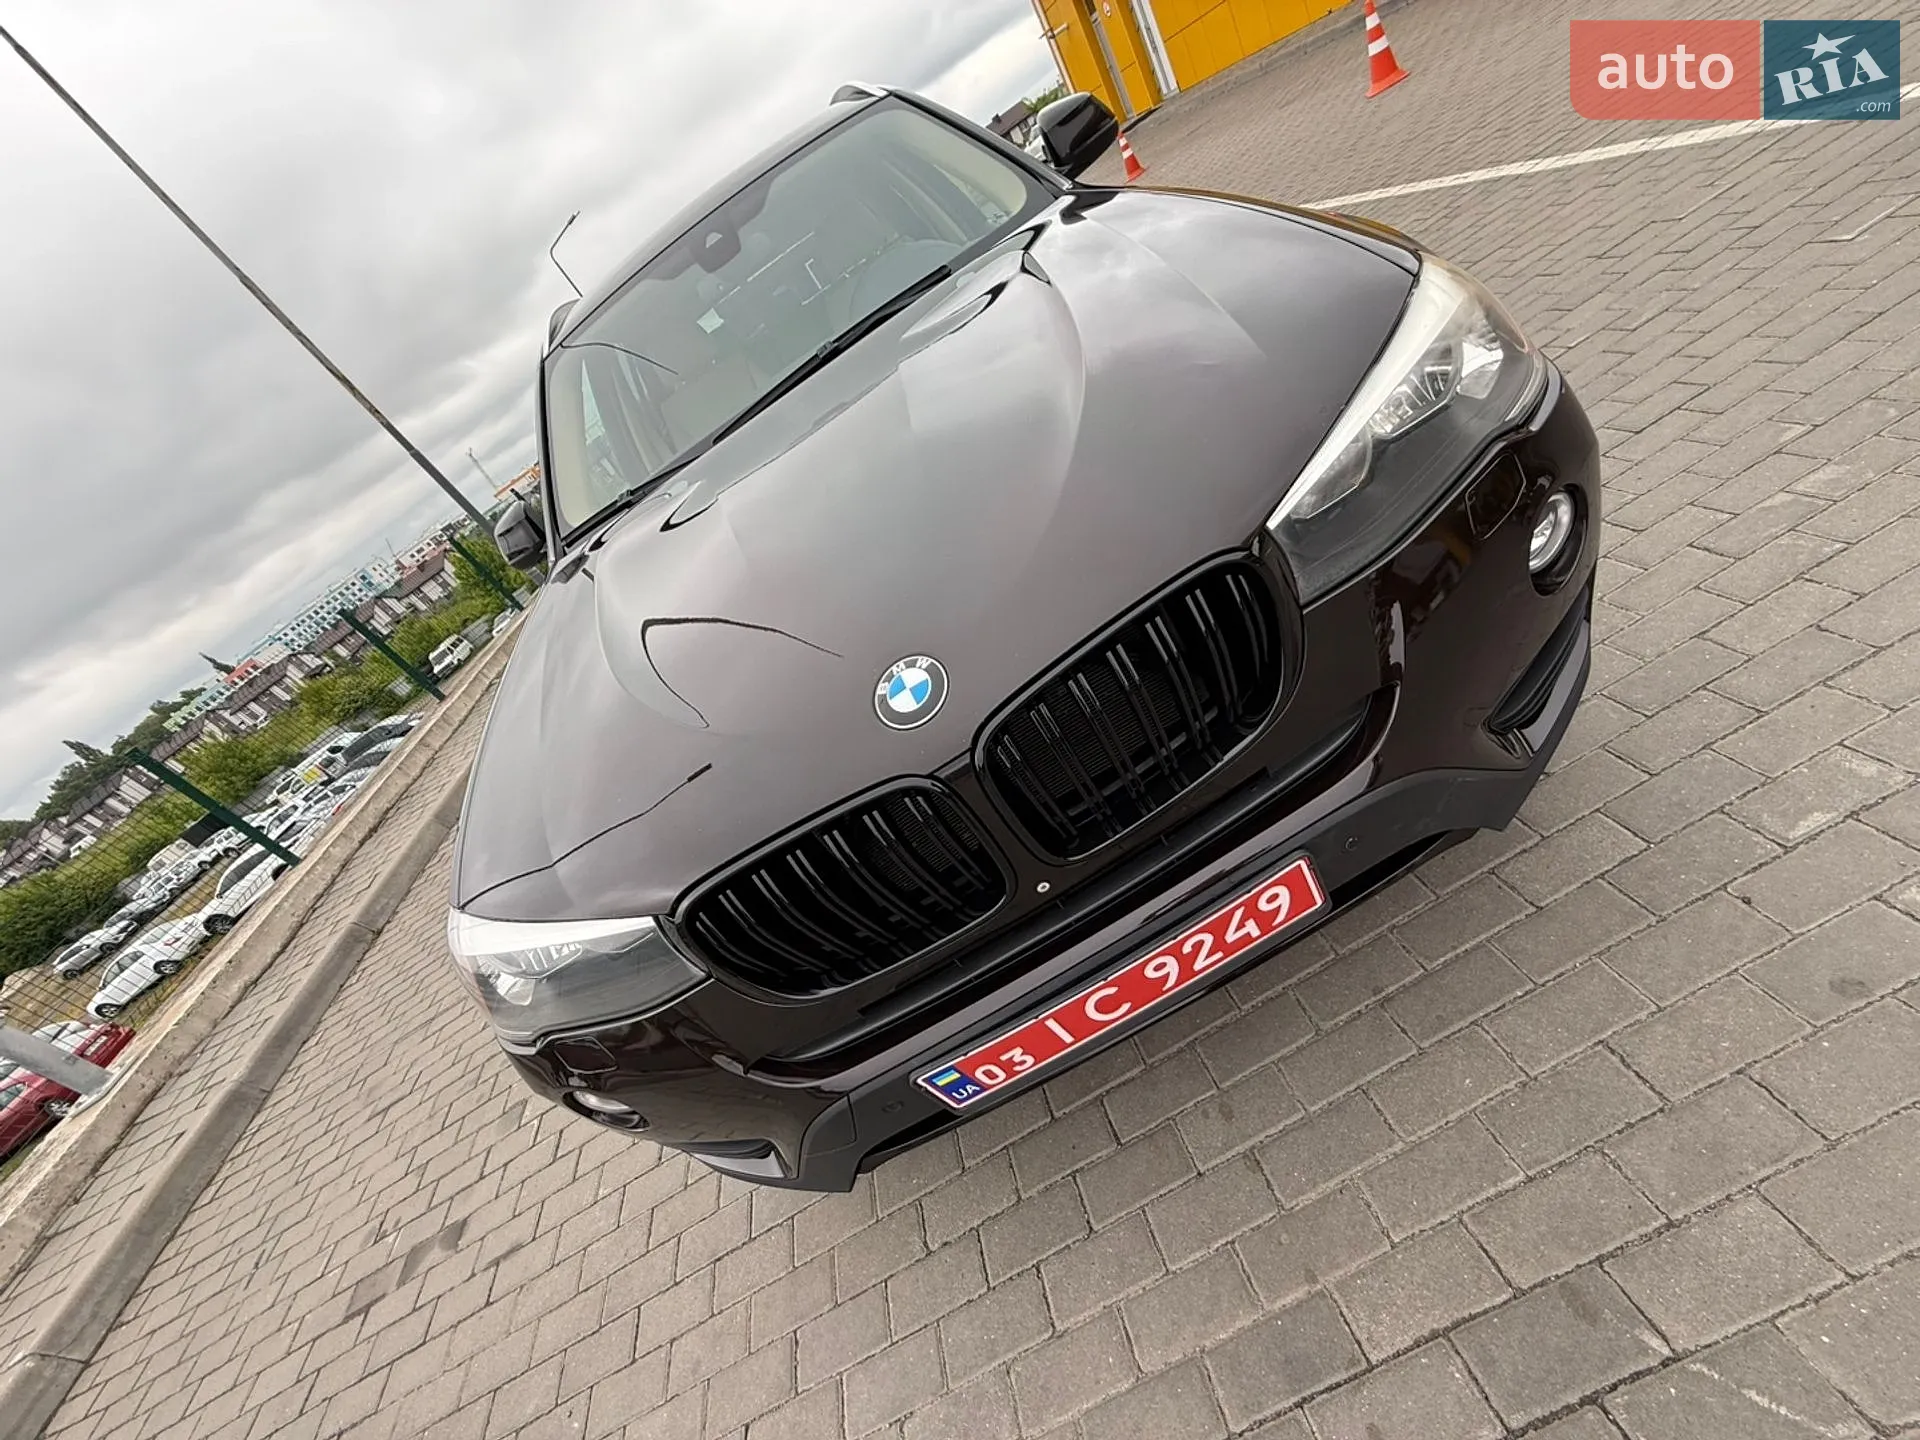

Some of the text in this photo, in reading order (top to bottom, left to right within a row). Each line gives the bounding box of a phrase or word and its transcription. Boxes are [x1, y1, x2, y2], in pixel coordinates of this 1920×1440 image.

[877, 657, 932, 695] BMW
[974, 1046, 1035, 1086] 03
[1143, 885, 1290, 991] 9249
[952, 1082, 981, 1101] UA
